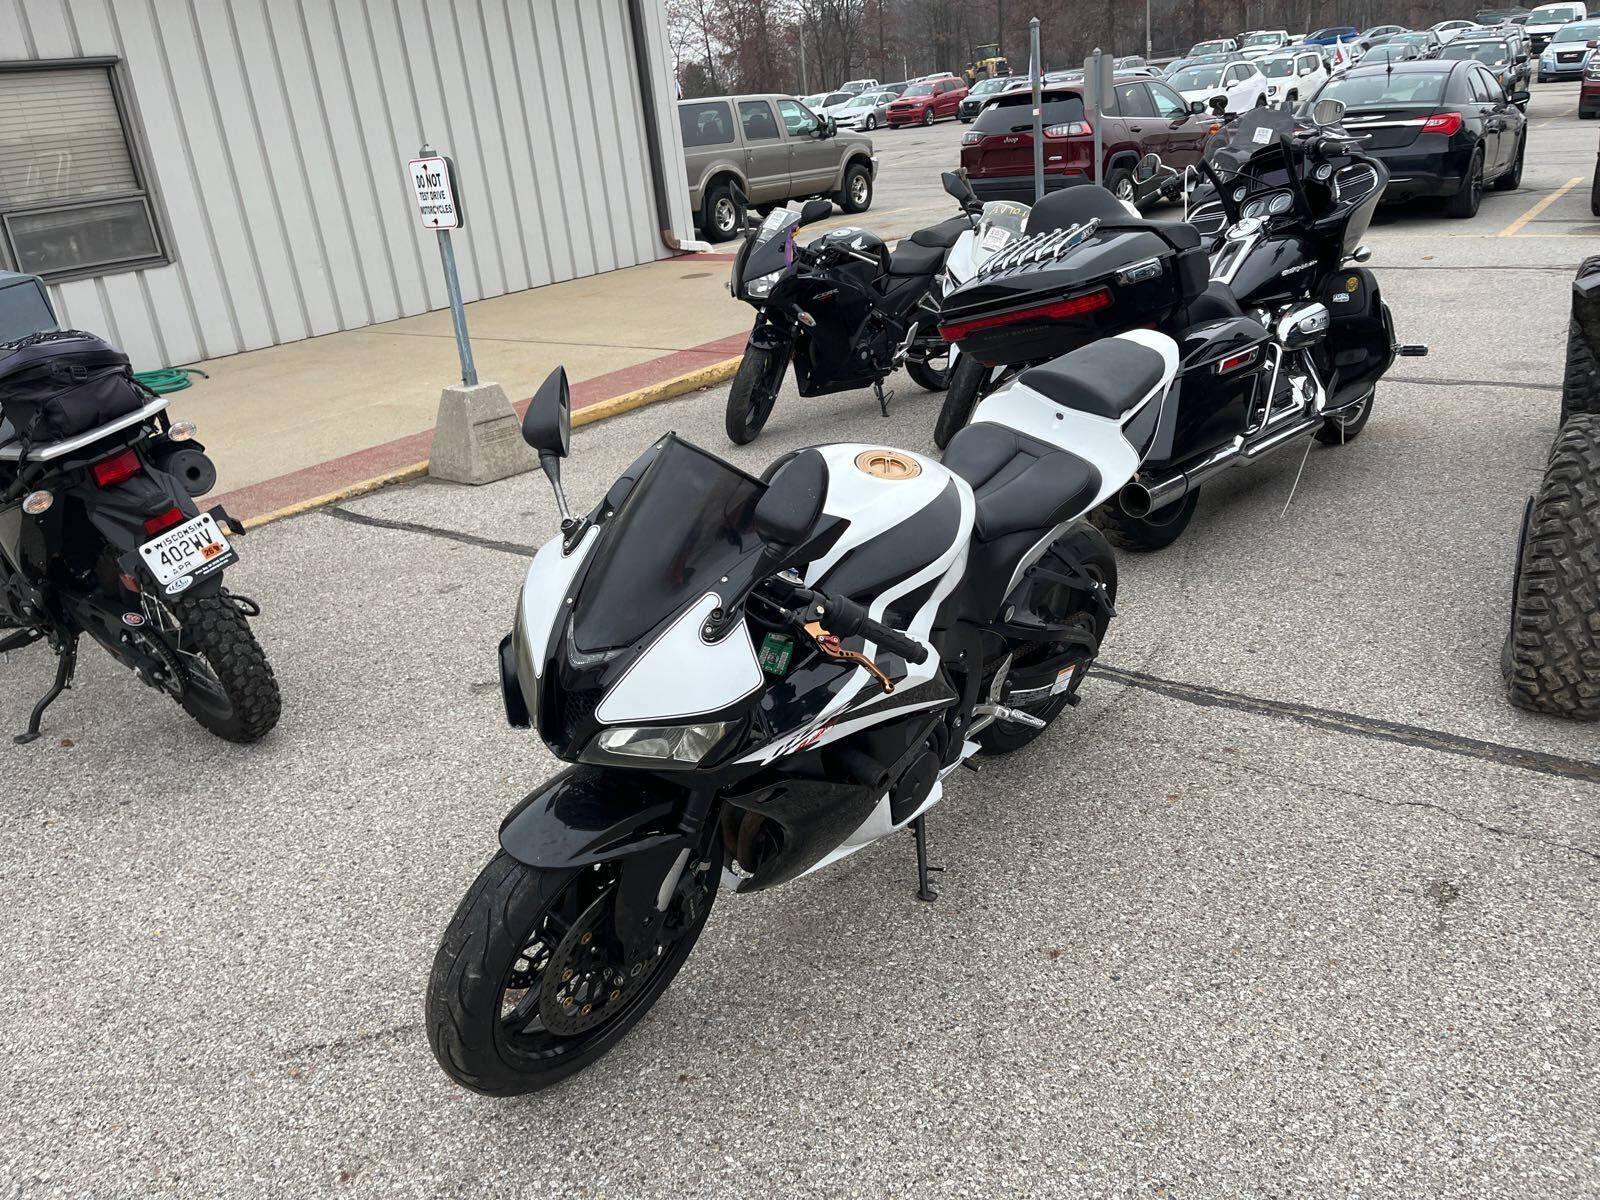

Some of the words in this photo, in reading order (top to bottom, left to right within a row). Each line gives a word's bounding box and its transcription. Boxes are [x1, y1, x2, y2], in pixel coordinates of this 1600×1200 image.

[416, 175, 425, 188] DO
[425, 173, 441, 188] NOT
[419, 192, 429, 201] TEST
[430, 190, 445, 200] DRIVE
[420, 204, 452, 214] MOTORCYCLES
[153, 521, 204, 550] WISCONSIN
[160, 528, 213, 566] 402WV
[172, 561, 191, 575] APR
